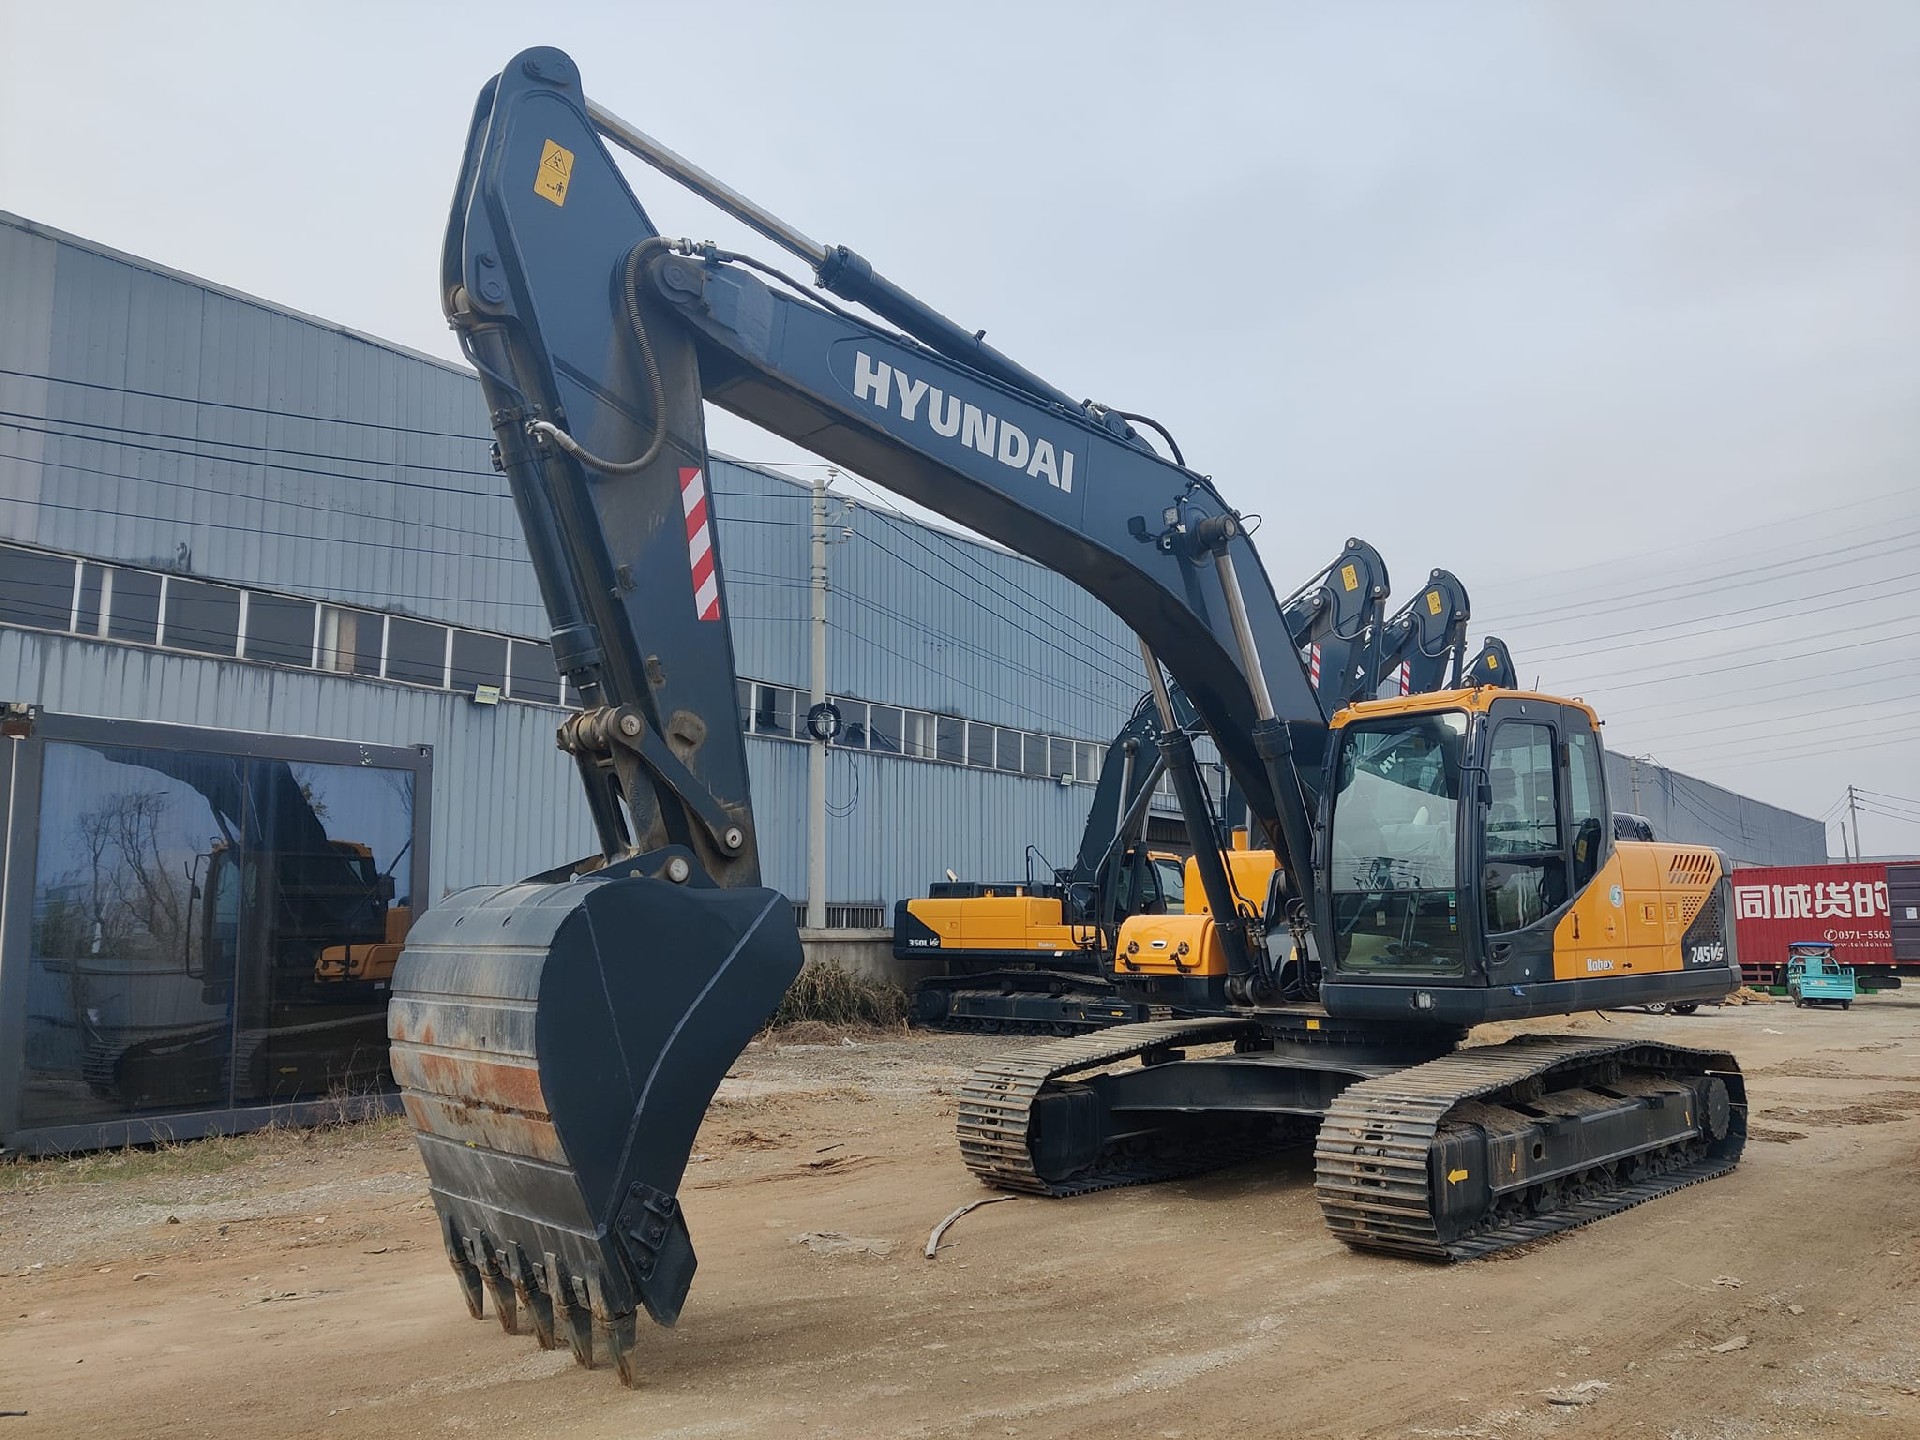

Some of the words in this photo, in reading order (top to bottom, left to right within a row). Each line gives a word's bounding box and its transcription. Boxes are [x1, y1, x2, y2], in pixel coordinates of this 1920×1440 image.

[854, 350, 1074, 494] HYUNDAI
[1734, 881, 1891, 920] 同城货的
[1838, 930, 1892, 940] 0371-5563
